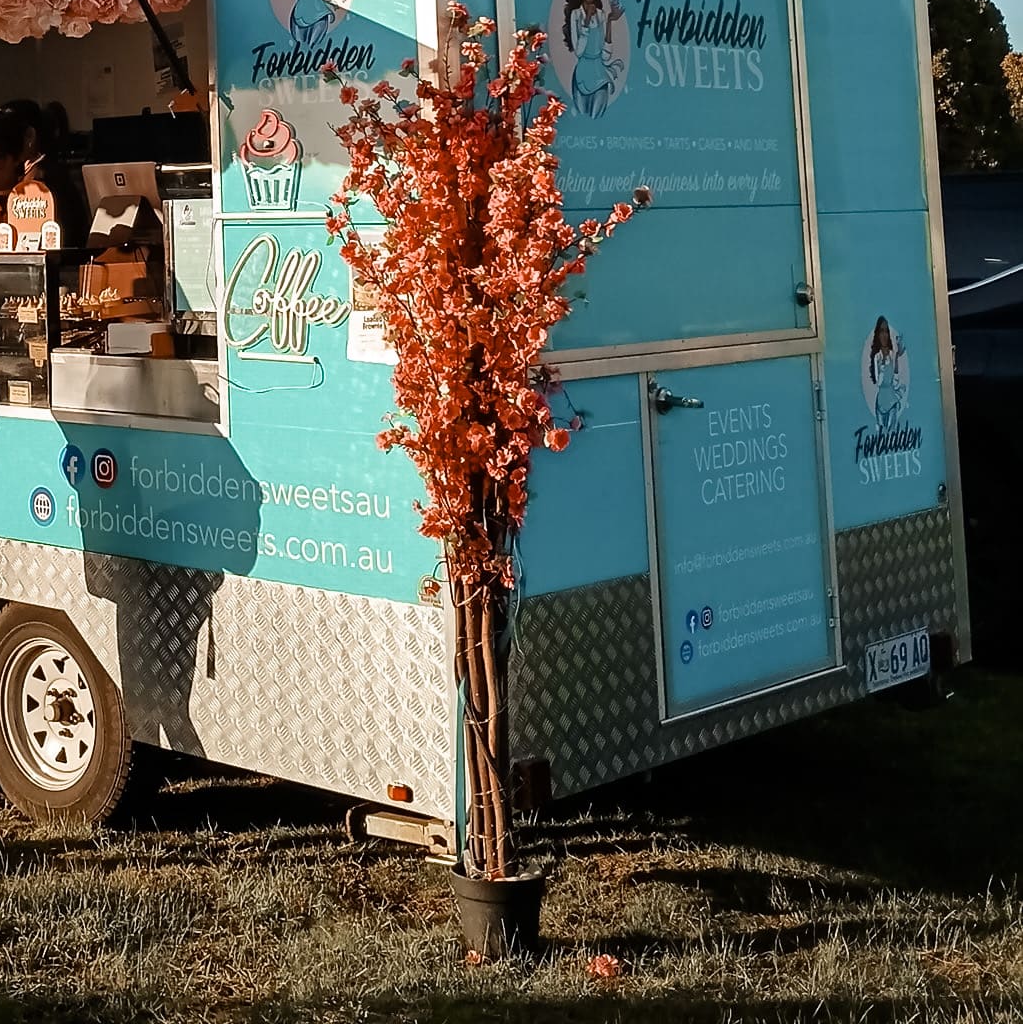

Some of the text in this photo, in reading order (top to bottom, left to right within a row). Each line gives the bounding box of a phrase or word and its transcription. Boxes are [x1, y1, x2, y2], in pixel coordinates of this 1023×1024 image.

[251, 36, 376, 83] Forbidden
[644, 42, 764, 92] SWEETS
[607, 137, 655, 150] BROWNIES
[664, 138, 690, 150] TARTS
[698, 139, 726, 151] CAKES
[734, 140, 753, 151] AND
[754, 140, 778, 151] MORE
[555, 168, 782, 205] aking sweet happiness into every bite
[224, 235, 352, 354] Coffee
[708, 403, 772, 439] EVENTS
[693, 433, 788, 473] WEDDINGS
[854, 424, 922, 463] Forbidden
[130, 456, 390, 519] forbiddensweetsau
[700, 466, 786, 505] CATERING
[858, 451, 922, 485] SWEETS
[66, 495, 393, 573] forbiddensweets.com.au
[868, 650, 878, 682] X
[890, 642, 907, 674] 69
